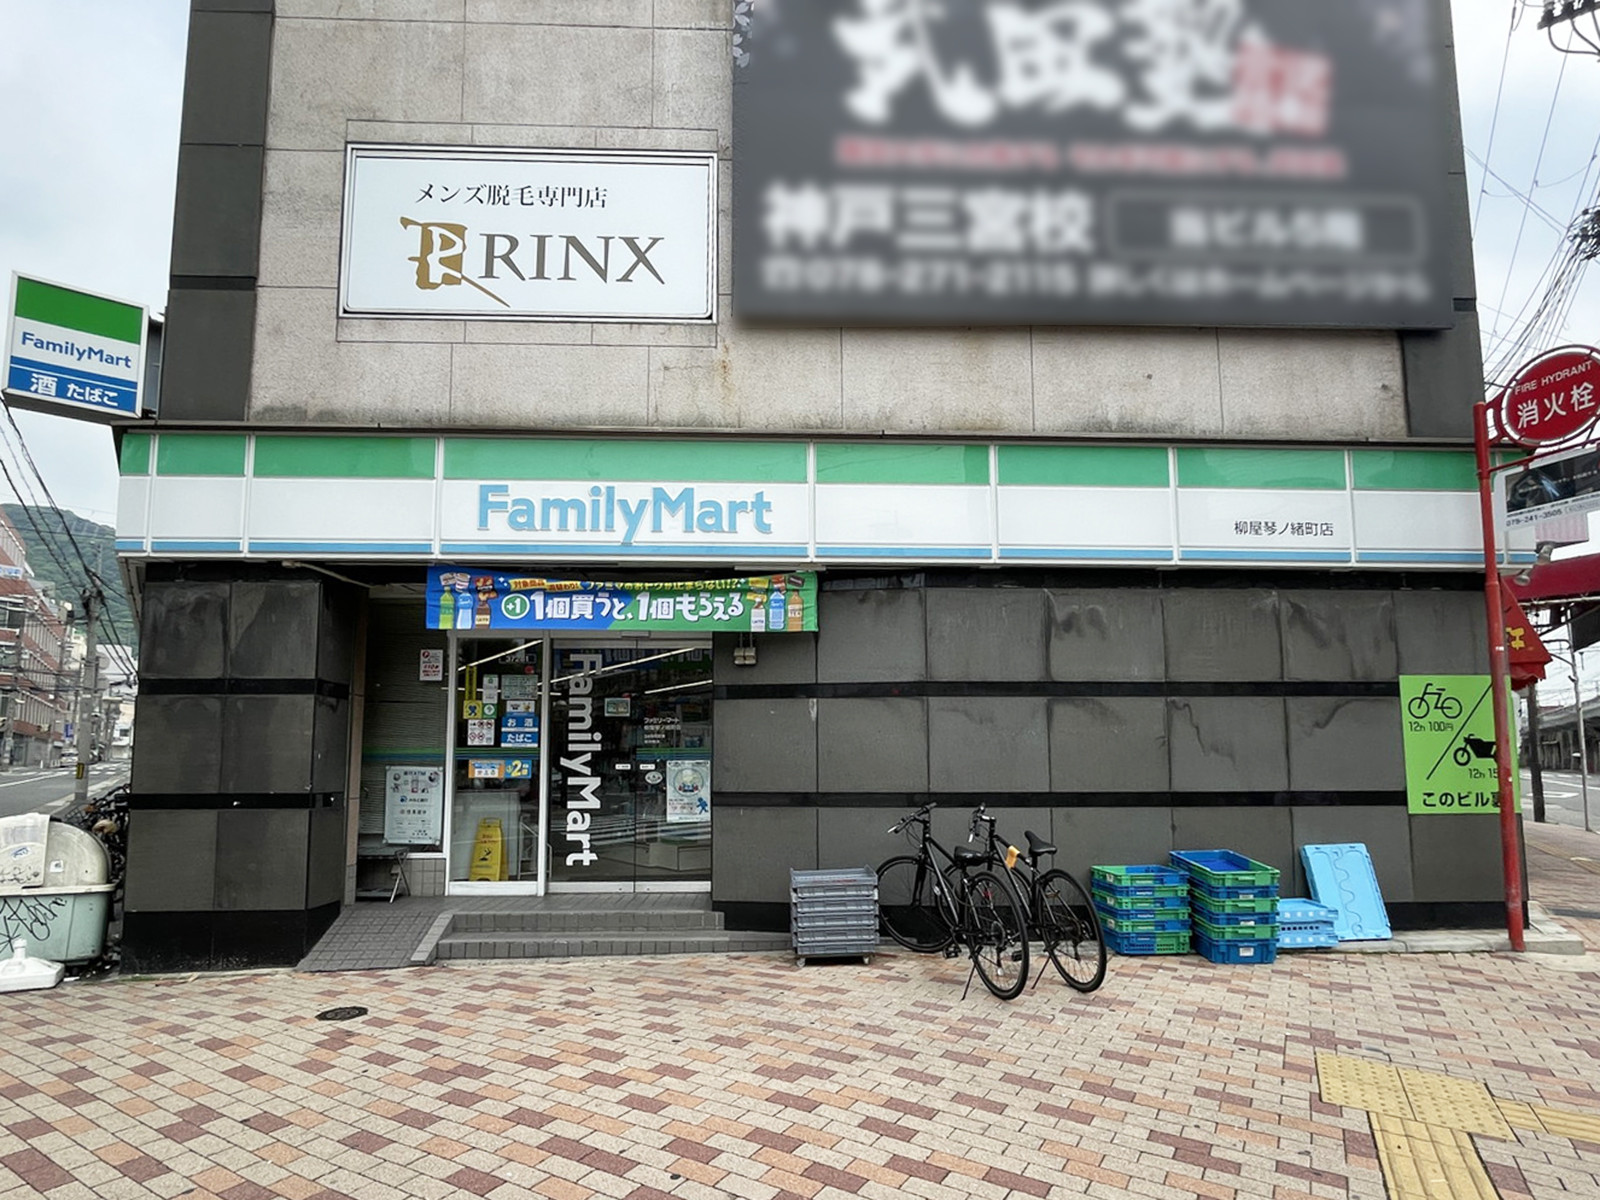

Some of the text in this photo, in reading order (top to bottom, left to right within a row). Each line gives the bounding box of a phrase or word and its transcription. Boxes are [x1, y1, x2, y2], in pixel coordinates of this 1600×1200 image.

[415, 183, 608, 209] メンズ脱毛専門店
[477, 233, 665, 285] RINX
[21, 331, 132, 369] FamilyMart
[29, 373, 119, 407] 酒 たばこ
[1514, 360, 1593, 396] FIRE HYDRANT
[1517, 381, 1596, 430] 消火栓
[477, 484, 773, 546] FamilyMart
[1234, 520, 1334, 537] 柳屋琴ノ緒町店
[507, 733, 533, 743] たばこ
[1408, 721, 1454, 732] 12h 100円
[560, 653, 603, 867] FamilyMart
[1468, 768, 1485, 779] 12h
